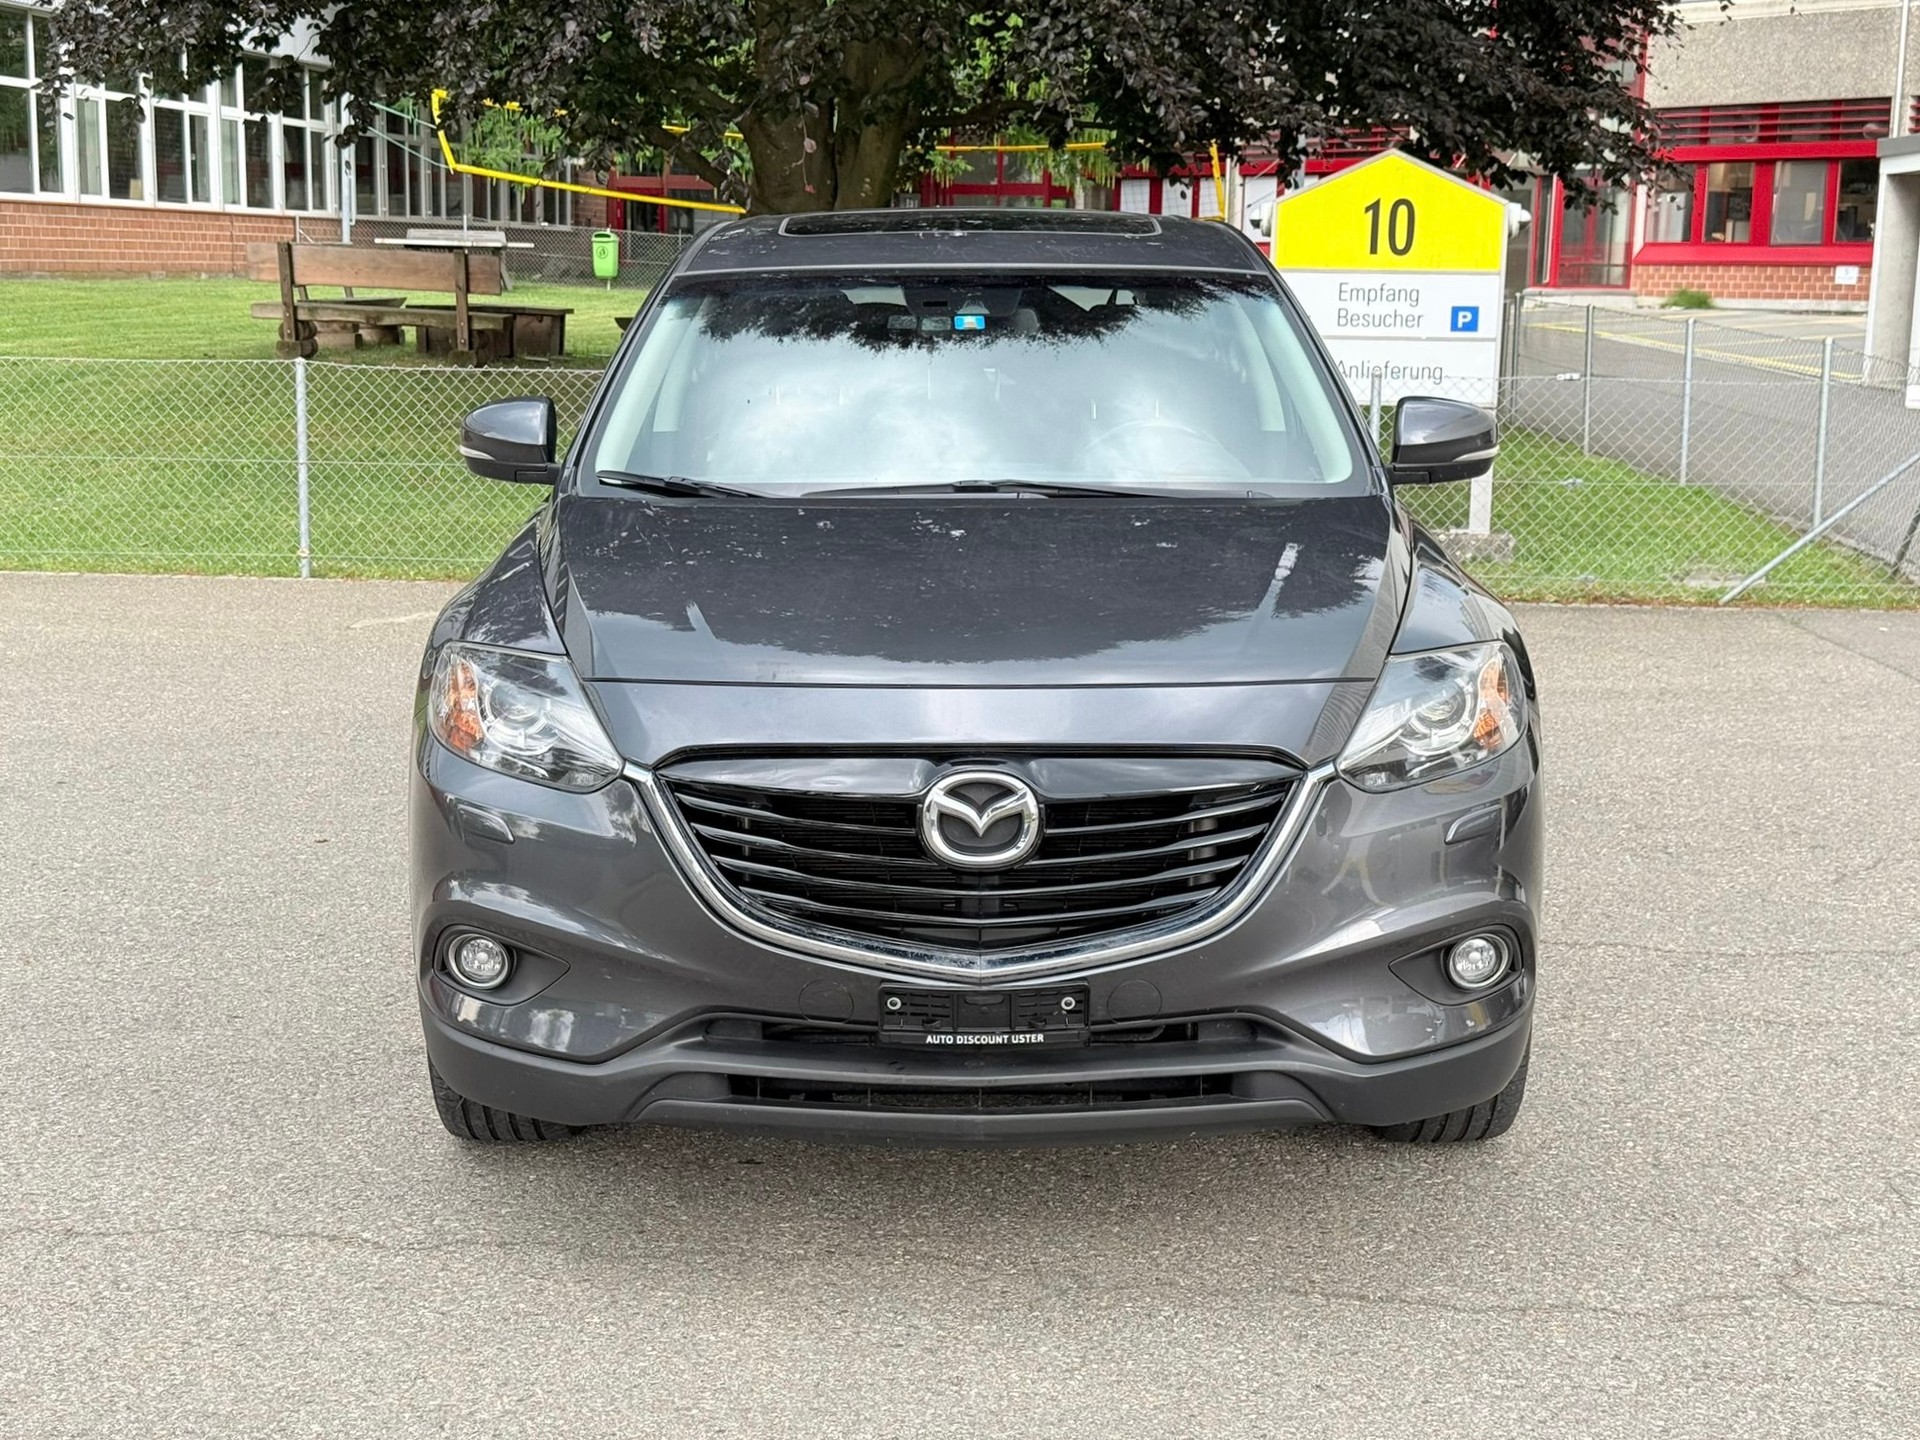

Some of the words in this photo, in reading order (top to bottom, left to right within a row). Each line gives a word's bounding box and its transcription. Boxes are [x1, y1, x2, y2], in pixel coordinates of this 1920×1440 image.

[1364, 197, 1416, 257] 10
[1338, 282, 1420, 308] Empfang
[1337, 307, 1424, 328] Besucher
[1457, 311, 1473, 329] P
[925, 1034, 954, 1045] AUTO
[956, 1034, 1009, 1045] DISCOUNT
[1011, 1033, 1045, 1044] USTER
